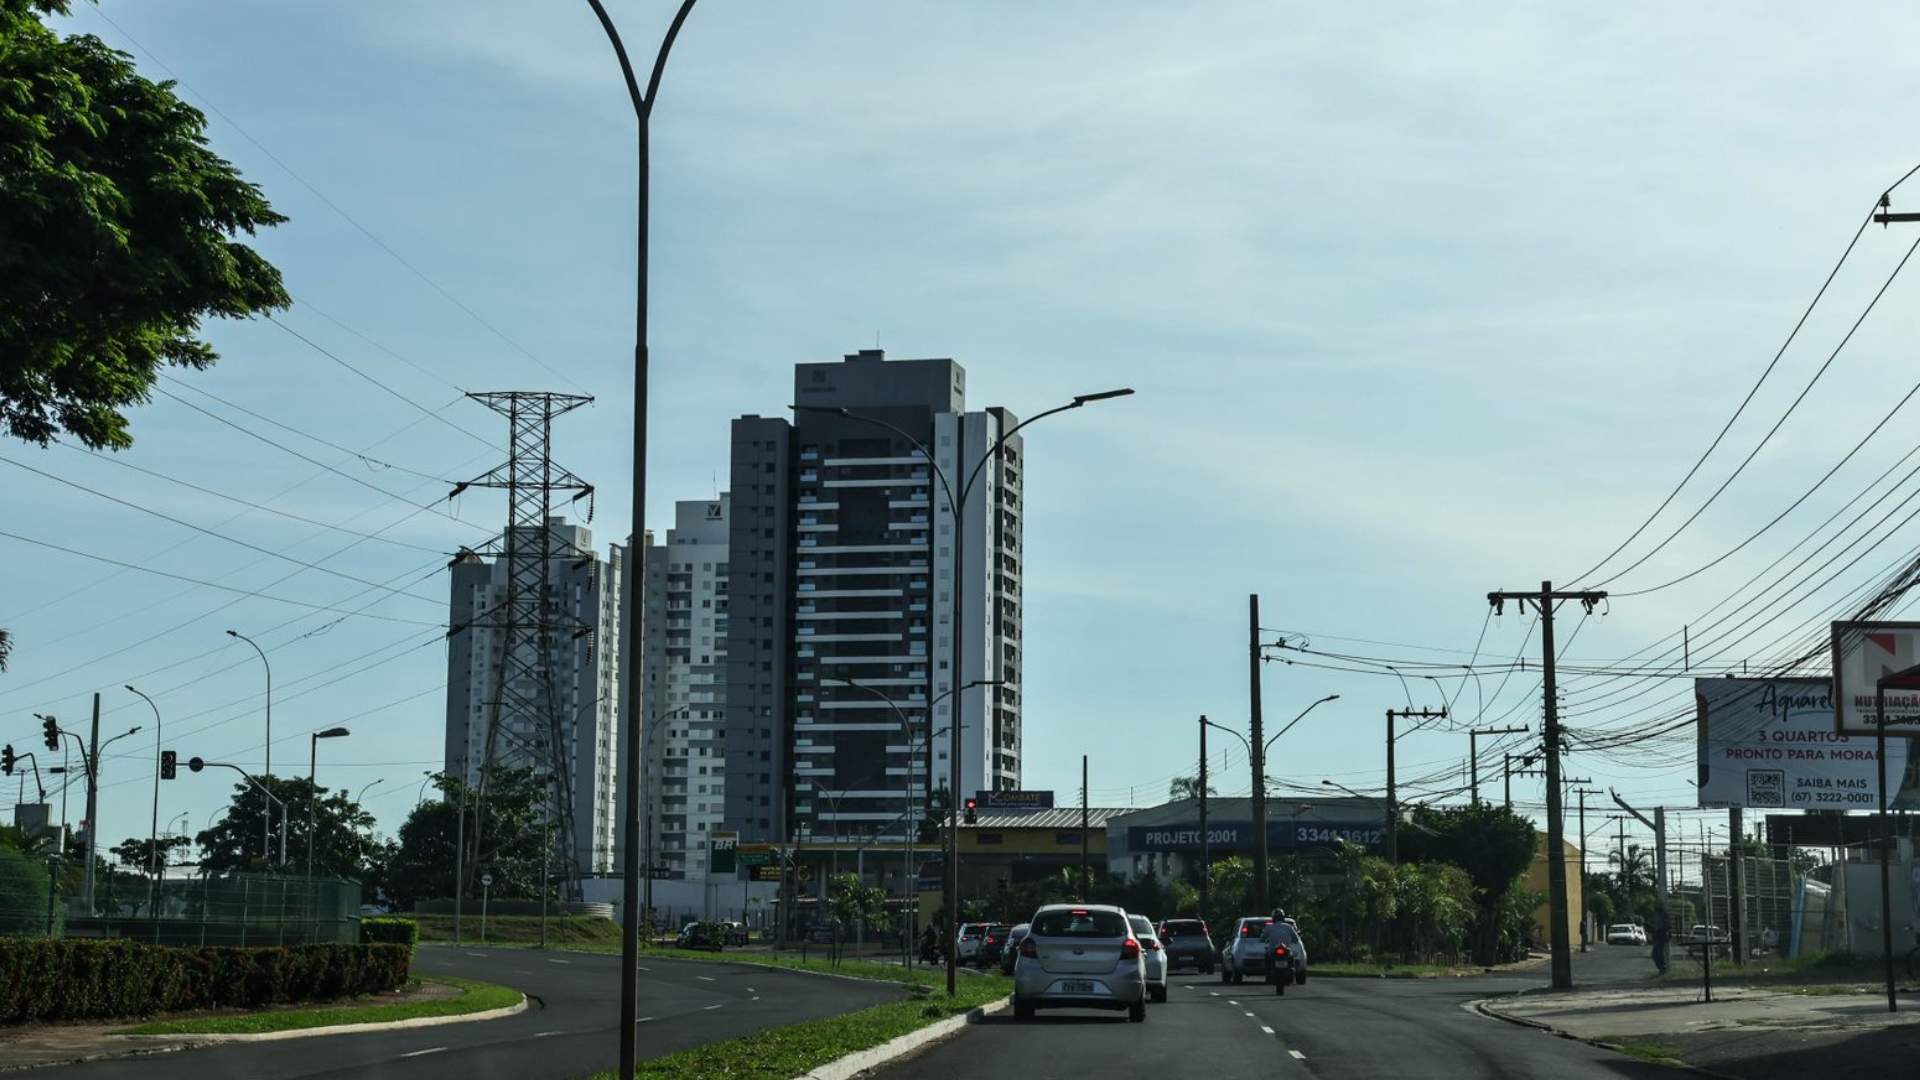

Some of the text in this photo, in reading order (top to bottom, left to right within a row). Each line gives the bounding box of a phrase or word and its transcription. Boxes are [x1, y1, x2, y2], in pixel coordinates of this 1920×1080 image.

[1855, 694, 1920, 709] NUTRIAÇÃ
[1758, 730, 1767, 742] 3
[1726, 748, 1783, 759] PRONTO
[1788, 749, 1825, 760] PARA
[1797, 777, 1868, 789] SAIBA MAIS
[1791, 791, 1874, 803] (67) 3222-0001
[1145, 829, 1237, 845] PROJETO 2001
[714, 840, 733, 850] BR
